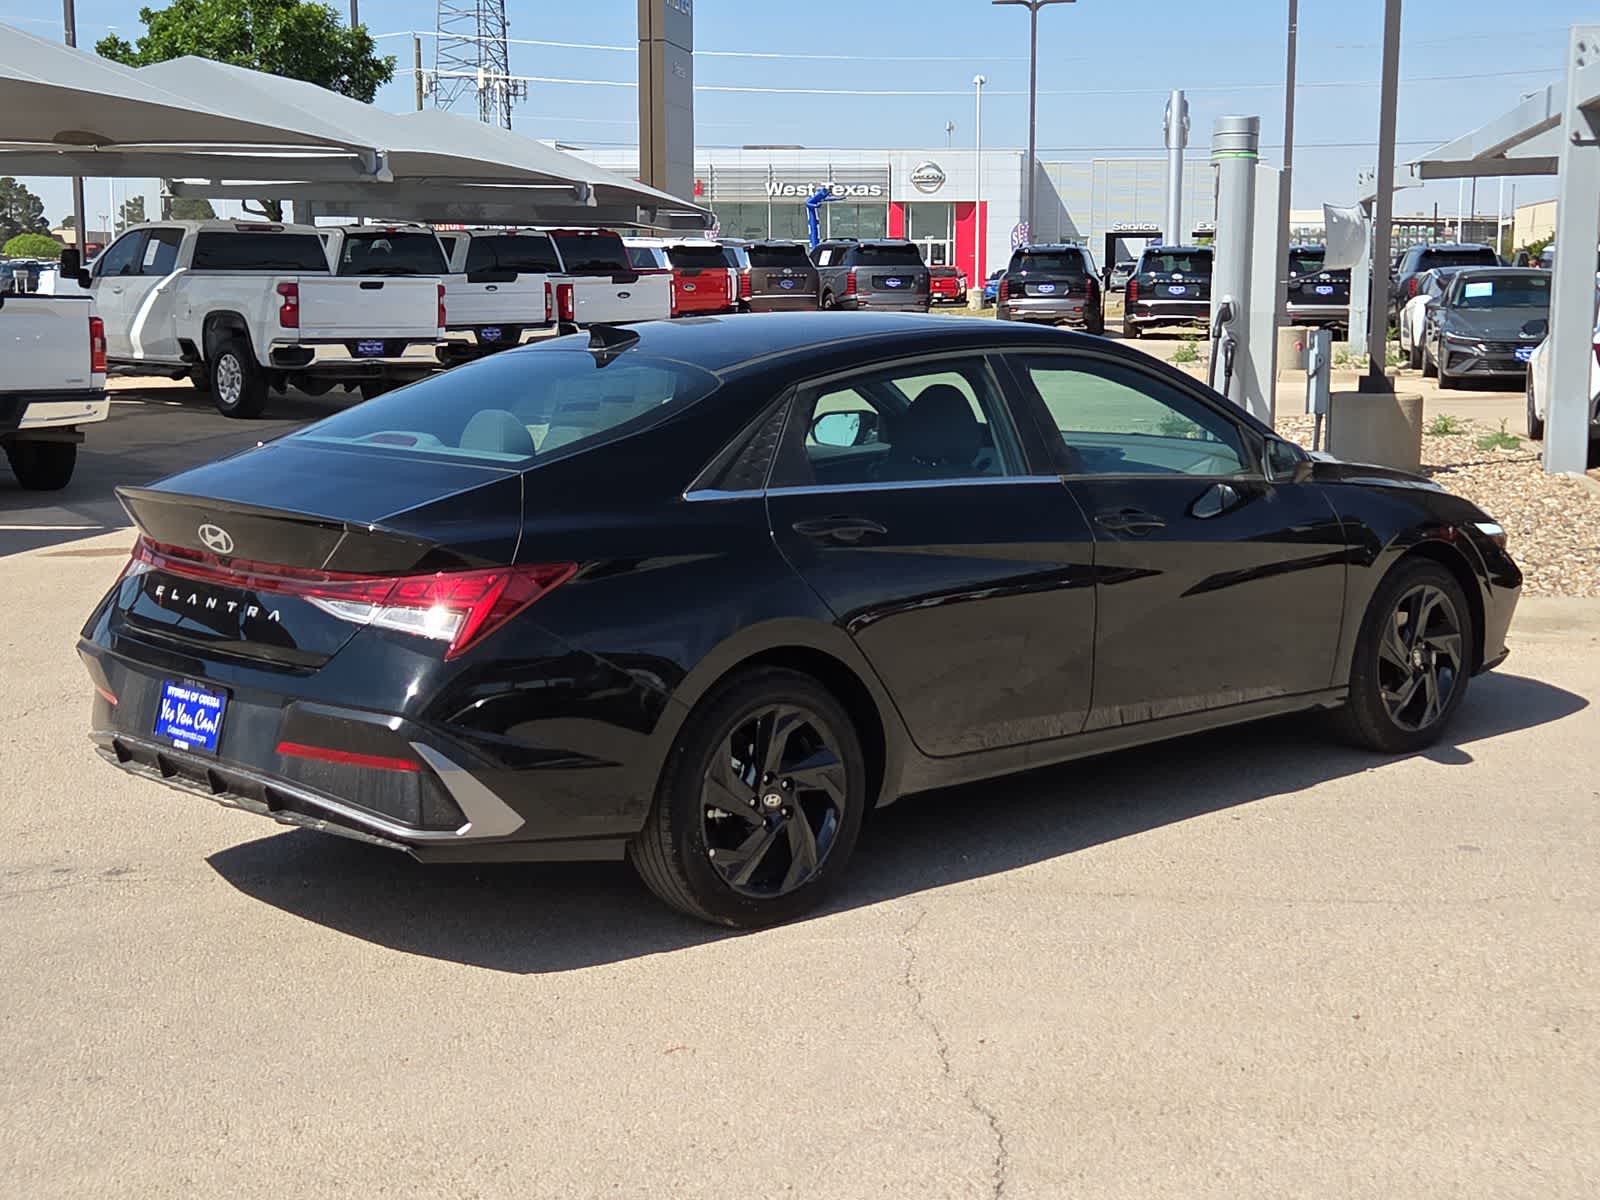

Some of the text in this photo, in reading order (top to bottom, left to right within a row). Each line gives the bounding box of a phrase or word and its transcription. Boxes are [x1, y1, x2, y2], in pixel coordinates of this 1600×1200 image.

[765, 182, 882, 197] West Texas
[1112, 222, 1159, 231] Service
[155, 585, 281, 622] ELANTRA
[160, 698, 175, 723] Yes
[175, 702, 193, 725] You
[194, 708, 220, 735] Can!
